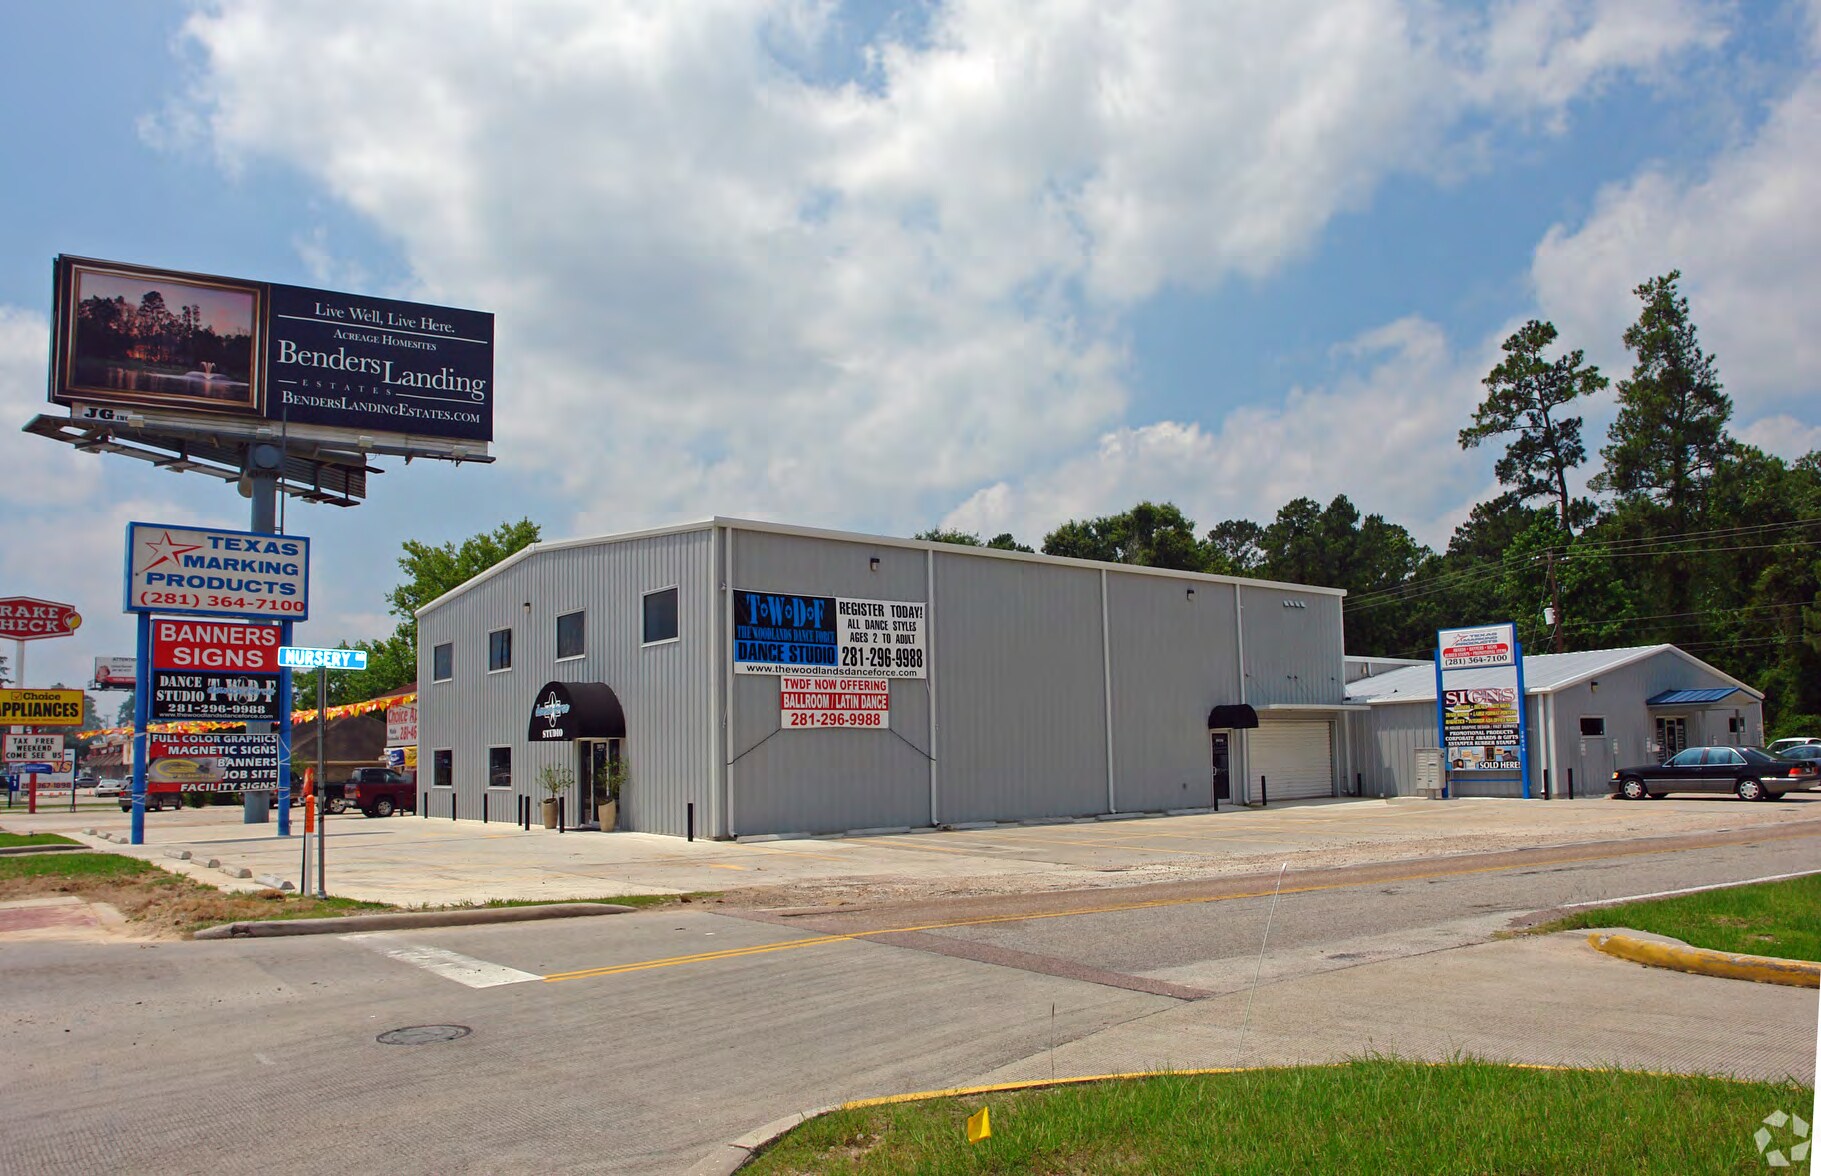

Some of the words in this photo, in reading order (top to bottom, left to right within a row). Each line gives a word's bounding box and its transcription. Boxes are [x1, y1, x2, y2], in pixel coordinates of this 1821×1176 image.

[314, 302, 344, 319] Live
[349, 307, 384, 326] Well,
[388, 313, 416, 328] Live
[421, 318, 455, 333] Here.
[302, 379, 392, 396] ESTATES
[84, 407, 115, 420] JG
[207, 536, 299, 556] TEXAS
[183, 555, 299, 576] MARKING
[146, 572, 297, 596] PRODUCTS
[140, 591, 200, 608] (281)
[207, 595, 305, 612] 364-7100
[839, 602, 884, 617] REGISTER
[890, 605, 923, 619] TODAY!
[847, 619, 861, 630] ALL
[865, 620, 888, 631] DANCE
[892, 621, 916, 631] STYLES
[160, 624, 276, 646] BANNERS
[753, 627, 791, 641] WOODLANDS
[793, 629, 814, 643] DANCE
[815, 631, 836, 644] FORCE
[850, 633, 868, 643] AGES
[873, 633, 878, 643] 2
[882, 634, 891, 644] TO
[895, 634, 915, 644] ADULT
[172, 647, 264, 668] SIGNS
[285, 649, 351, 667] NURSERY
[738, 643, 784, 661] DANCE
[789, 645, 835, 664] STUDIO
[842, 647, 923, 668] 281-296-9988
[1445, 658, 1466, 666] (281)
[1468, 655, 1508, 664] 364-7100
[746, 664, 917, 677] www.thewoodlandsdanceforce.com
[159, 675, 202, 688] DANCE
[783, 679, 811, 690] TWDF
[814, 679, 837, 690] NOW
[840, 680, 887, 691] OFFERING
[23, 692, 61, 701] Choice
[156, 689, 205, 702] STUDIO
[783, 694, 829, 709] BALLROOM
[835, 695, 859, 709] LATIN
[861, 695, 886, 709] DANCE
[1446, 688, 1515, 705] SIGNS
[0, 702, 79, 717] PPLIANCES
[168, 703, 266, 714] 281-296-9988
[159, 712, 274, 720] www.thewoodlandsdanceforce.com
[790, 713, 880, 726] 281-296-9988
[152, 734, 179, 743] FULL
[182, 735, 221, 743] COLOR
[223, 734, 277, 743] GRAPHICS
[542, 729, 563, 738] STUDIO
[168, 745, 237, 755] MAGNETIC
[240, 745, 277, 754] SIGNS
[217, 758, 277, 767] BANNERS
[1480, 761, 1499, 769] SOLD
[1500, 761, 1520, 769] HERE!
[222, 770, 248, 780] JOB
[251, 770, 277, 778] SITE
[180, 783, 236, 792] FACILITY
[240, 782, 276, 790] SIGNS
